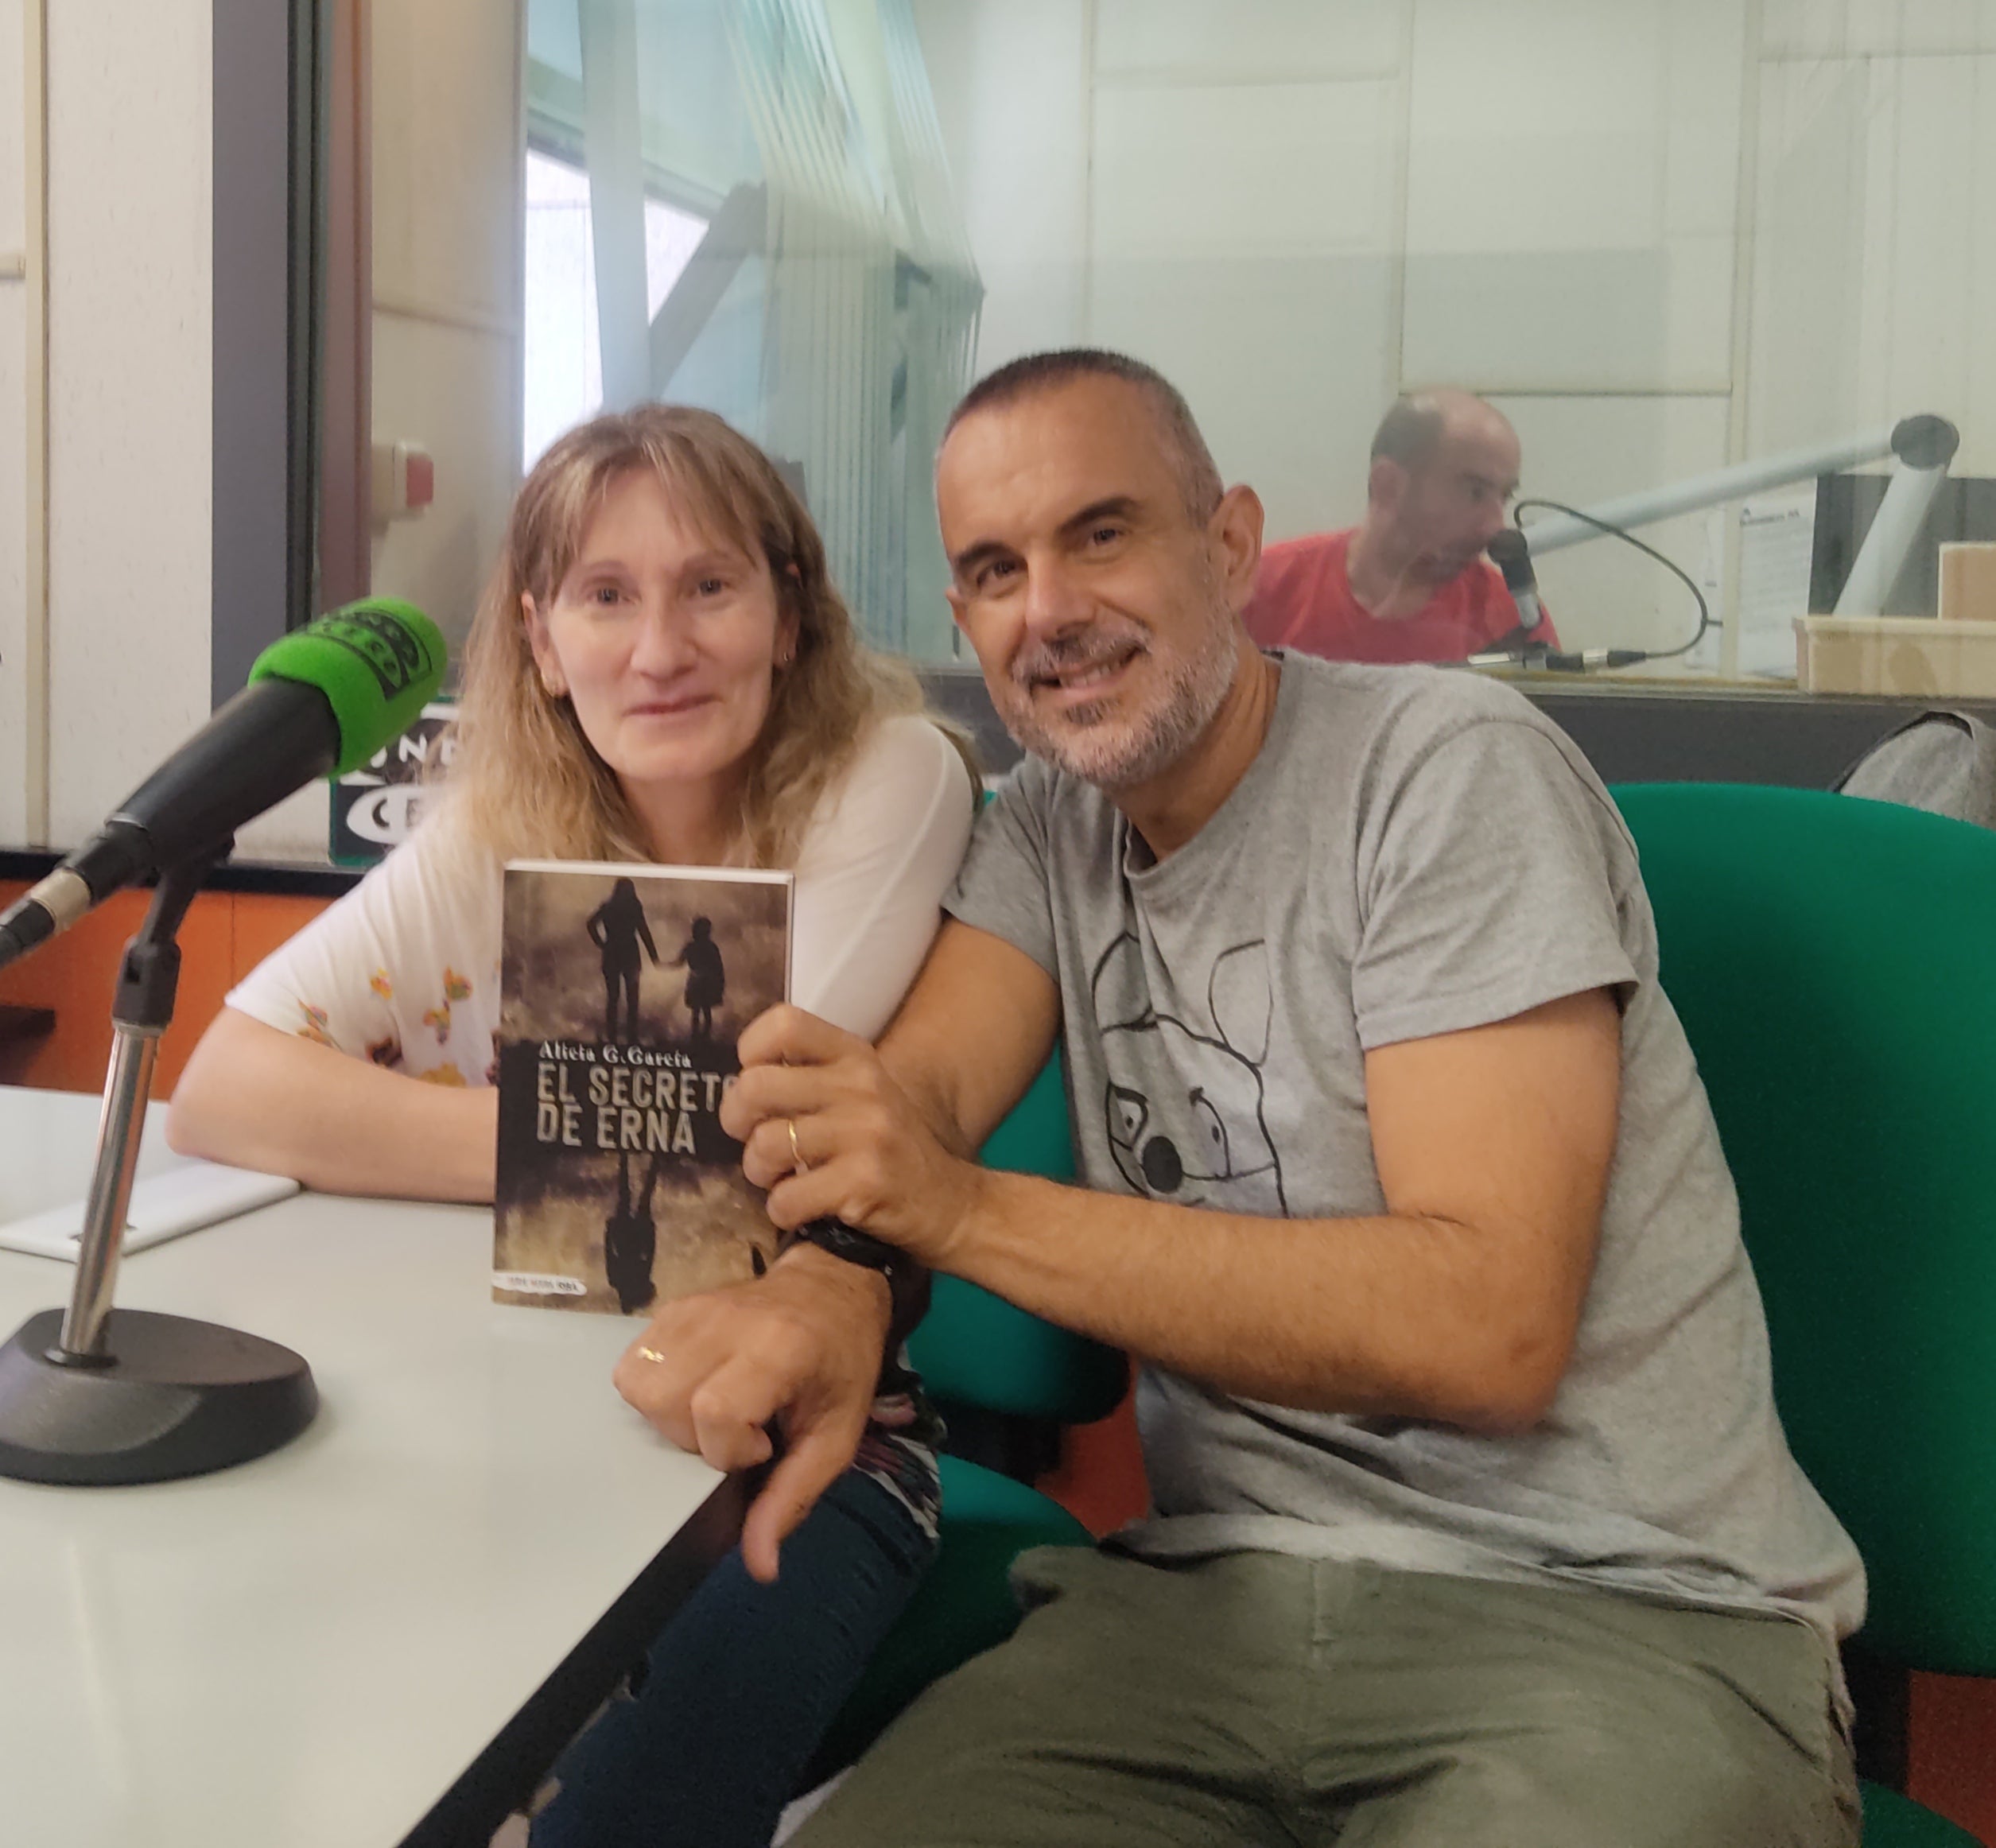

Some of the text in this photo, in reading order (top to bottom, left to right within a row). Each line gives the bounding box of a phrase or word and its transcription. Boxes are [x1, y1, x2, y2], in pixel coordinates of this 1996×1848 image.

[539, 1039, 596, 1062] Alicia
[603, 1044, 627, 1064] G.
[537, 1062, 577, 1105] EL
[536, 1103, 697, 1155] DE ERNA
